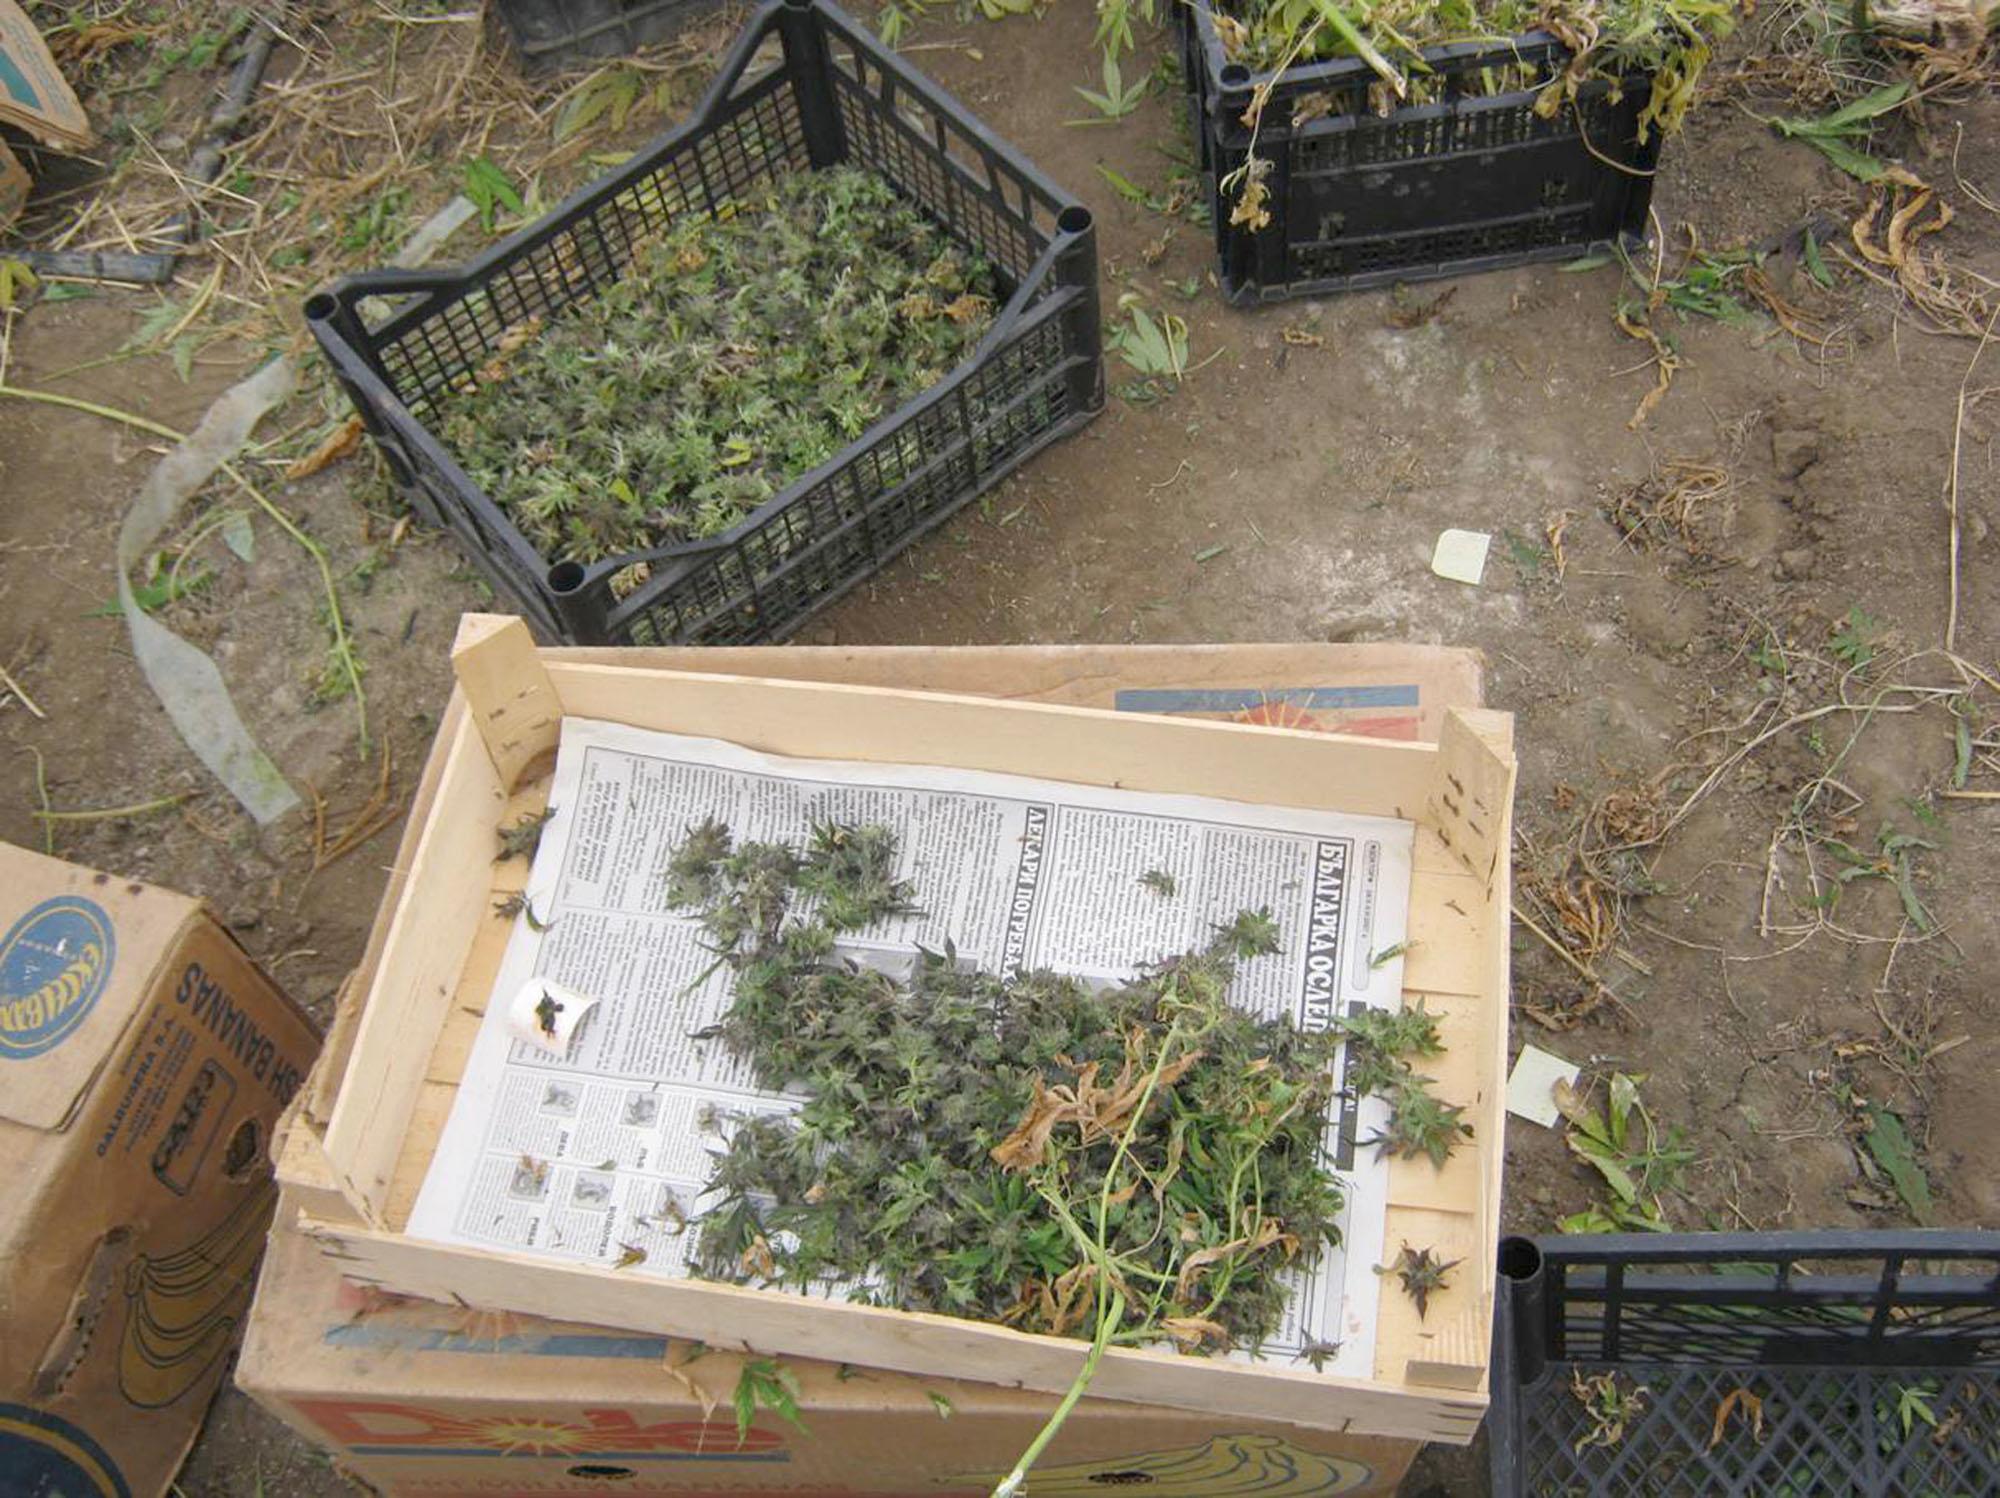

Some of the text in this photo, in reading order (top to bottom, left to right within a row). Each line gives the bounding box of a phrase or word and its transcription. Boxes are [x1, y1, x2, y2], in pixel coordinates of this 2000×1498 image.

[1001, 808, 1047, 989] ЛЕКАРИ ПОГРЕБАХ
[1302, 844, 1346, 1036] БЪЛГАРКА ОСЛЕП
[176, 962, 276, 1082] BANANAS
